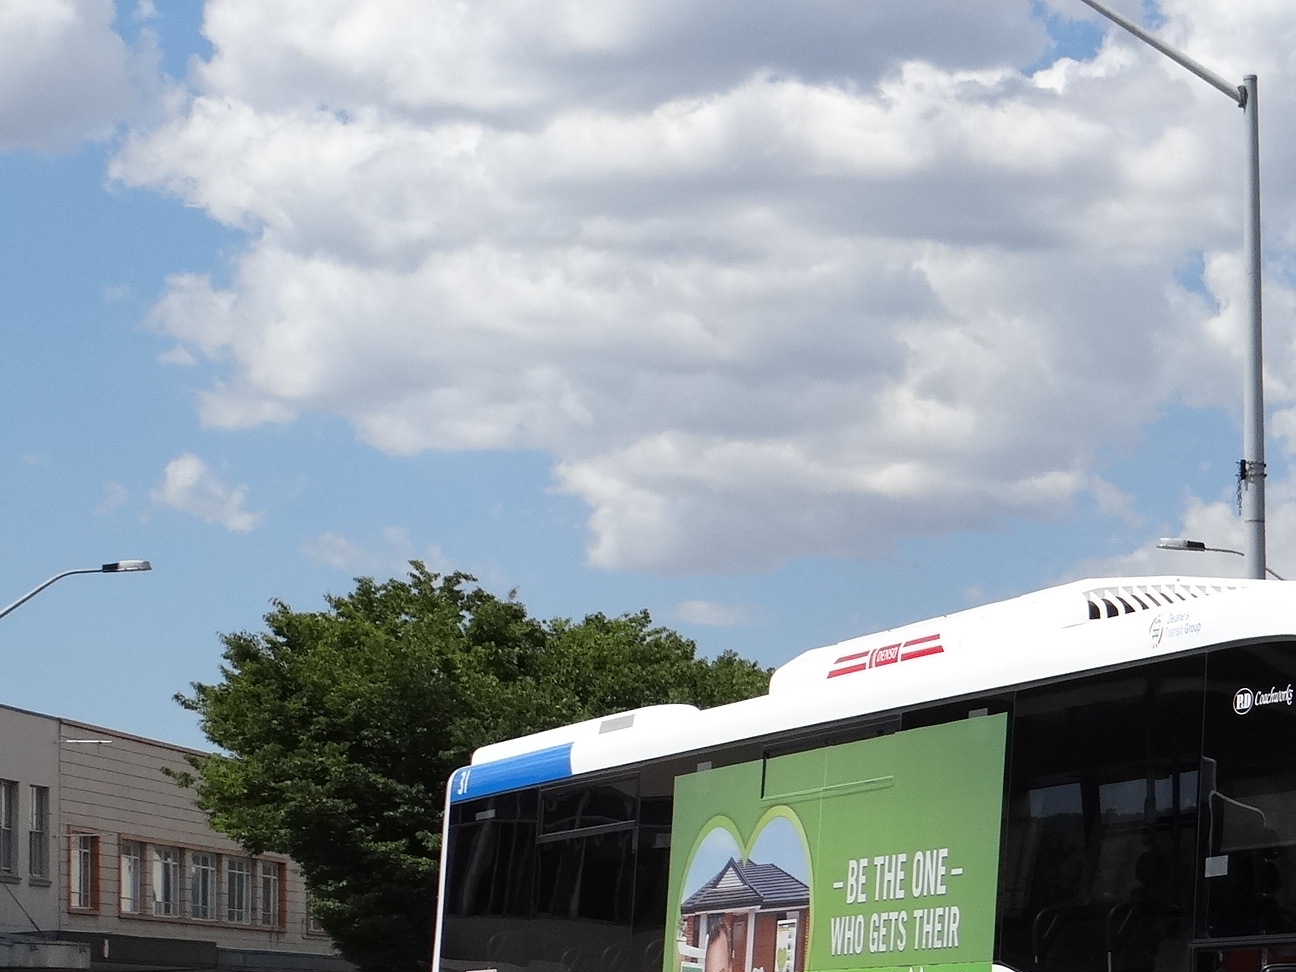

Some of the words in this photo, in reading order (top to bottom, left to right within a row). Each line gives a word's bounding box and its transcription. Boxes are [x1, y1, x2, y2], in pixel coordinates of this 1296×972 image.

[876, 646, 899, 662] DENSO
[873, 853, 907, 901] THE
[830, 912, 865, 956] WHO
[868, 909, 908, 953] GETS
[913, 905, 961, 950] THEIR
